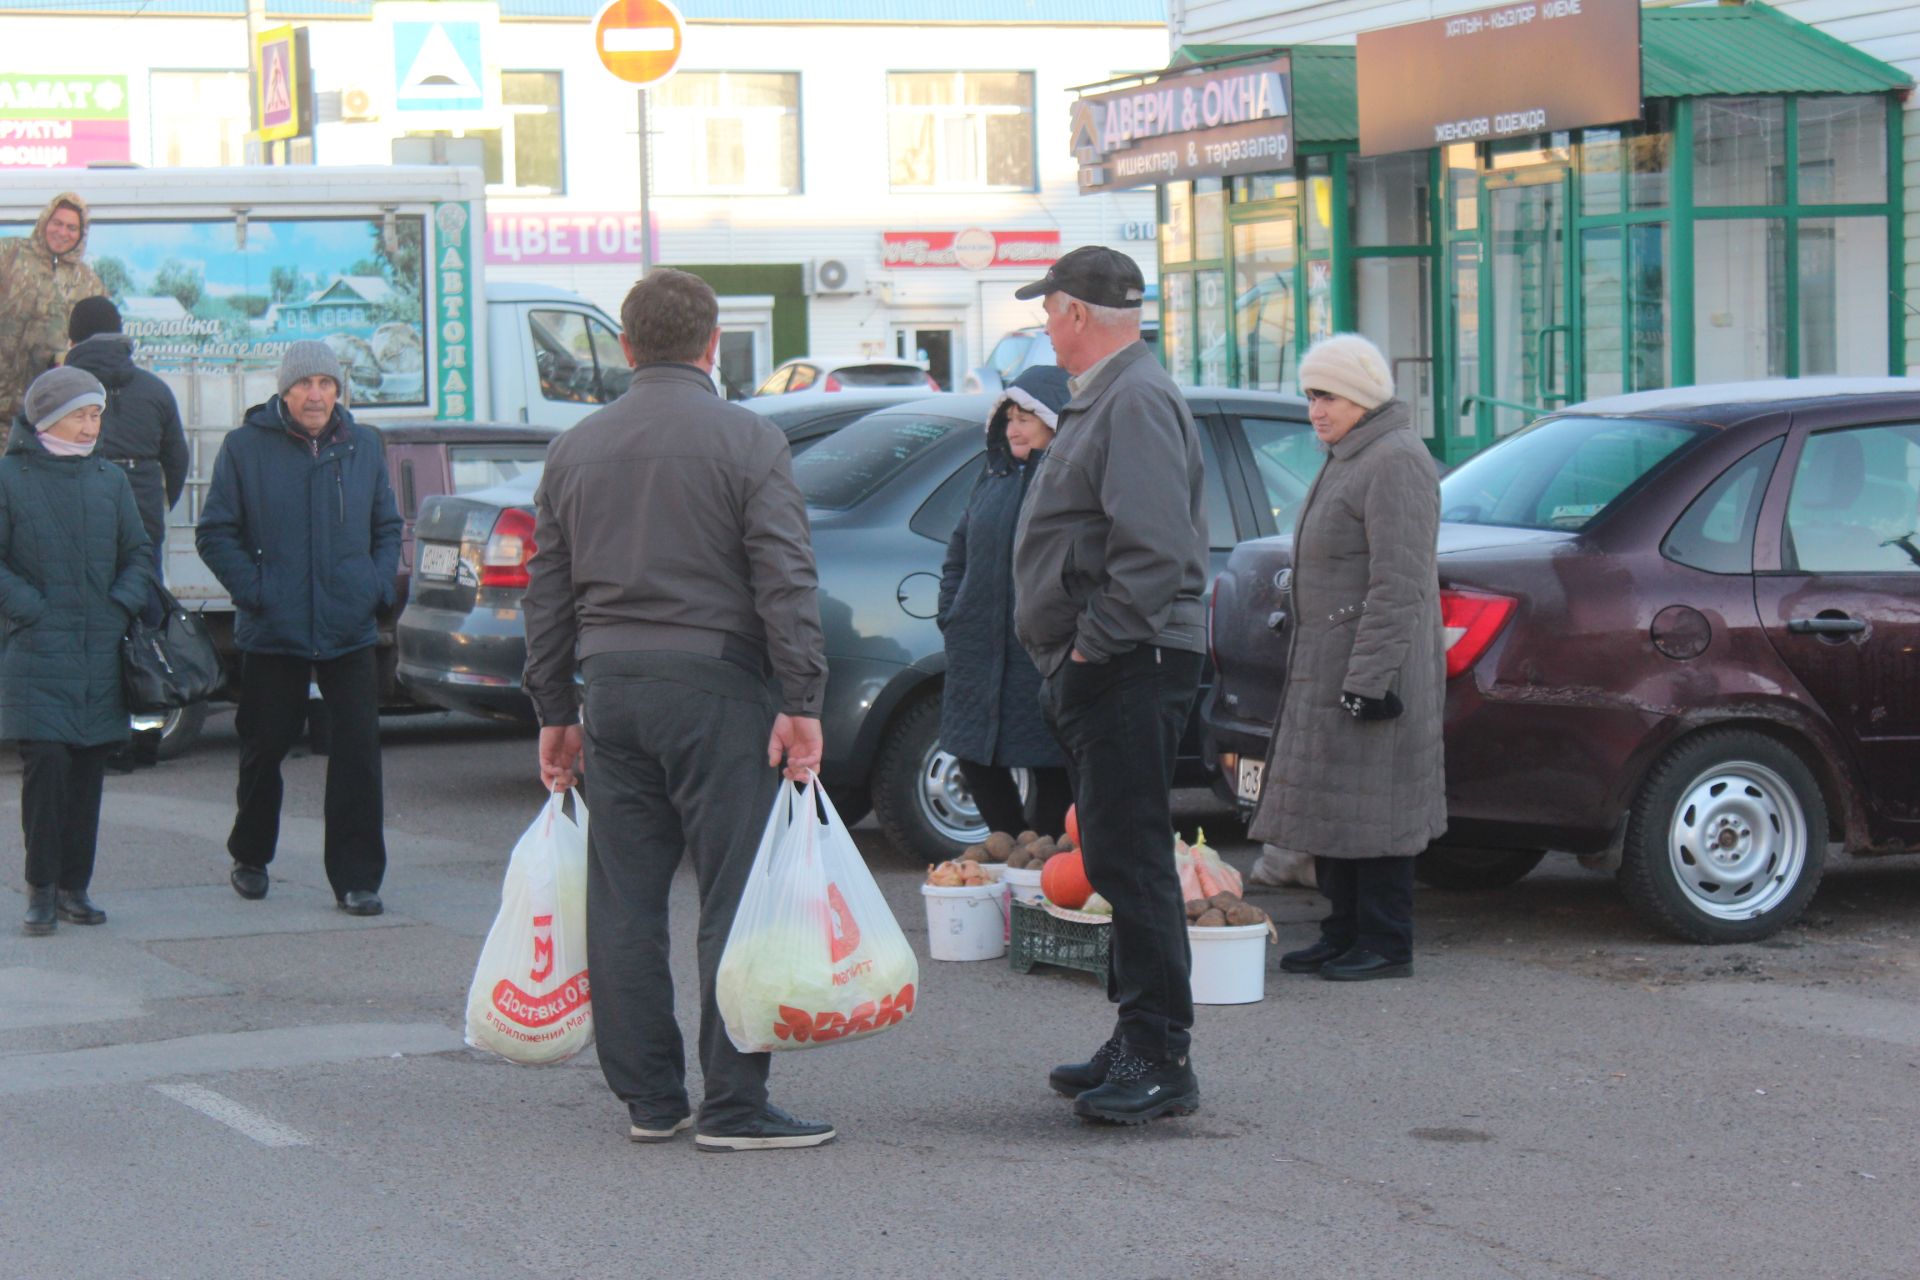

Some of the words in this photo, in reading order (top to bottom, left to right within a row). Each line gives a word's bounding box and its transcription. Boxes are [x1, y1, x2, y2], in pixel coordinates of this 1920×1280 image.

[1542, 0, 1582, 19] КИЕМЕ
[1103, 89, 1174, 150] ДВЕРИ
[1181, 87, 1198, 131] &
[1202, 72, 1287, 127] ОКНА
[1435, 118, 1490, 142] ЖЕНСКАЯ
[1495, 109, 1546, 134] ОДЕЖДА
[1187, 141, 1199, 167] &
[440, 247, 467, 421] АВТОЛАВ
[493, 1017, 565, 1043] приложении
